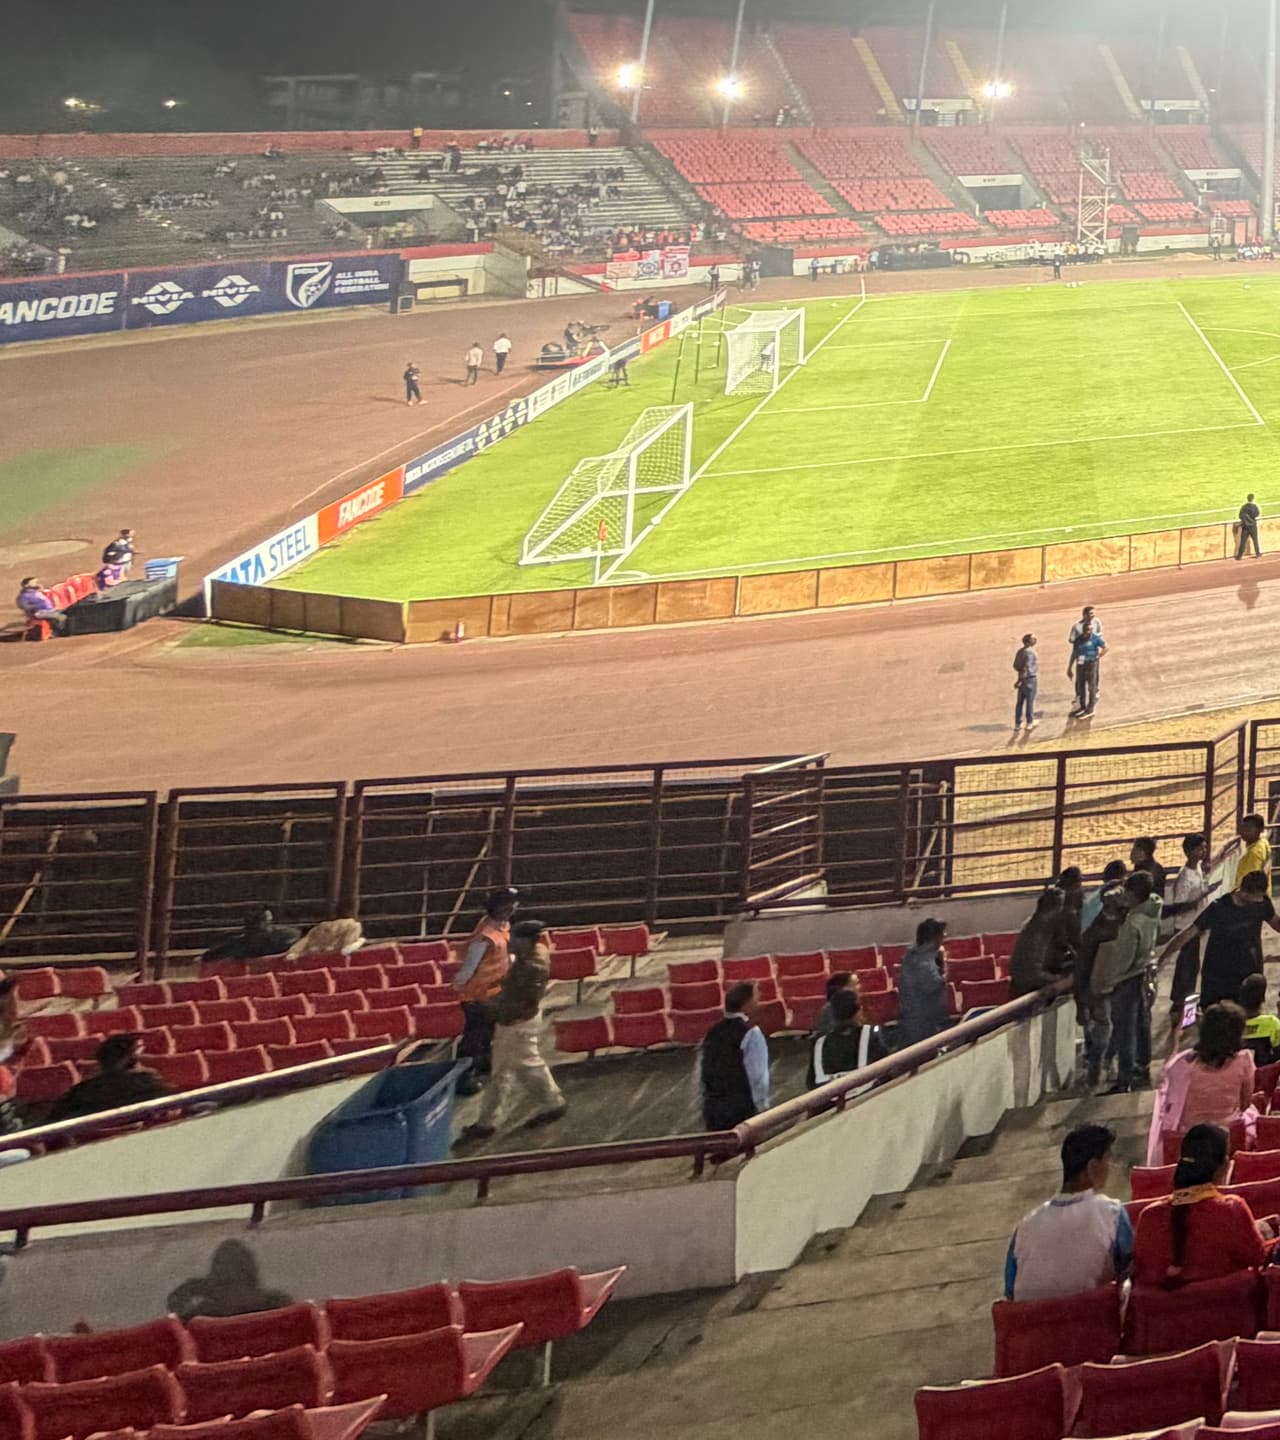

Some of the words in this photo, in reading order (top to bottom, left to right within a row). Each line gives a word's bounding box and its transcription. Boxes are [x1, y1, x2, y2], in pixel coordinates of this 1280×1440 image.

[0, 291, 118, 326] ANCODE
[131, 291, 195, 305] NIVIA
[202, 285, 261, 298] NIVIA
[338, 481, 385, 528] FANCODE
[218, 553, 266, 585] ATA
[269, 525, 311, 572] STEEL
